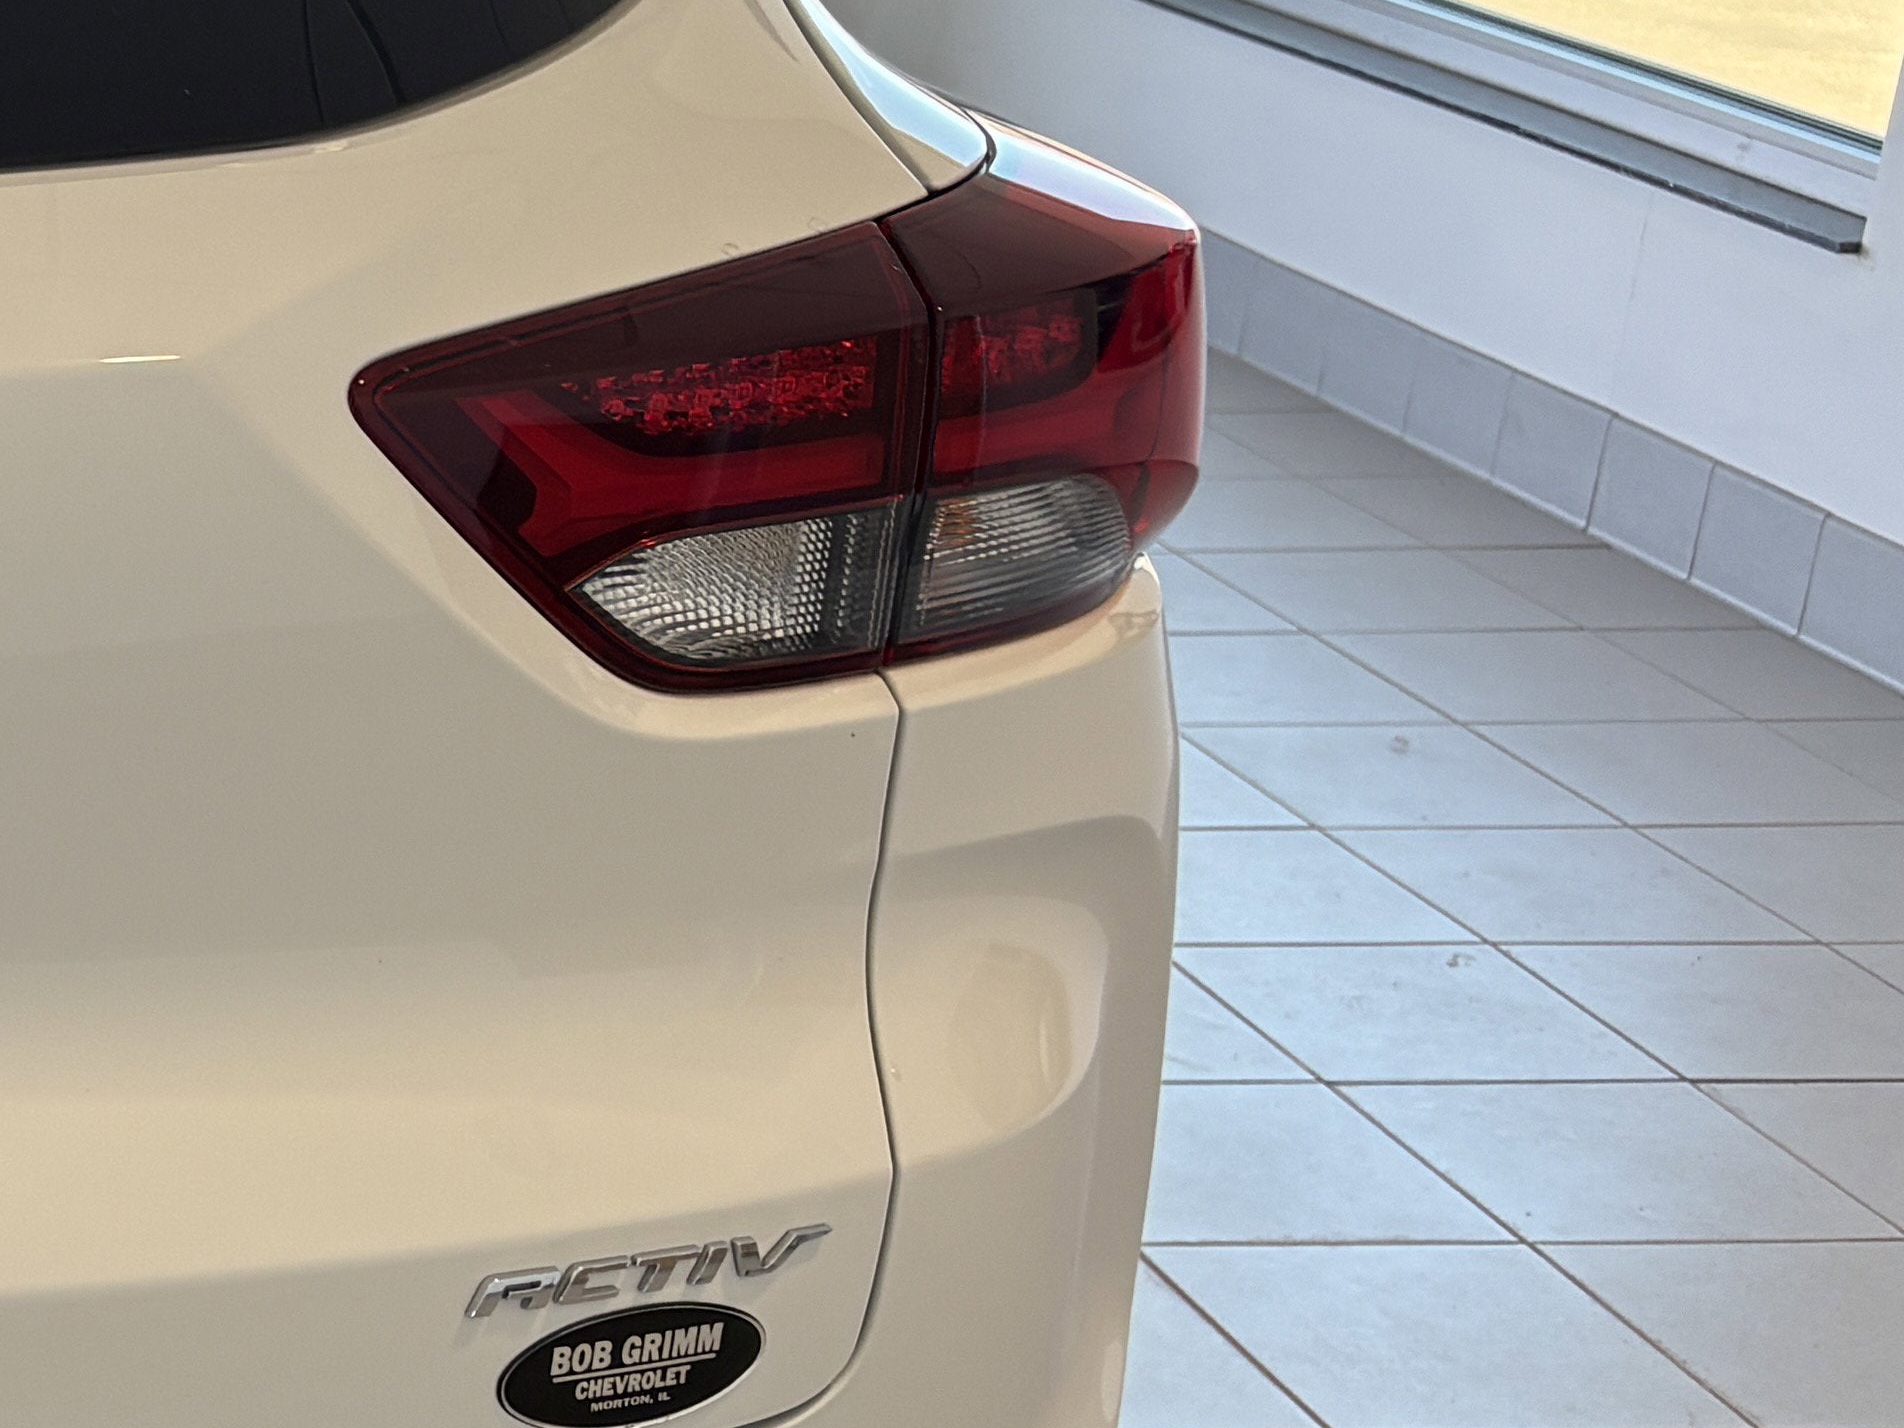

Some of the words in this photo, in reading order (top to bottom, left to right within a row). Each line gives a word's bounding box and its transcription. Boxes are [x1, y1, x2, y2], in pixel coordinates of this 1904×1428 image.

[464, 1222, 833, 1318] ACTIV
[550, 1341, 612, 1377] BOB
[621, 1322, 724, 1365] GRIMM
[575, 1364, 691, 1401] CHEVROLET
